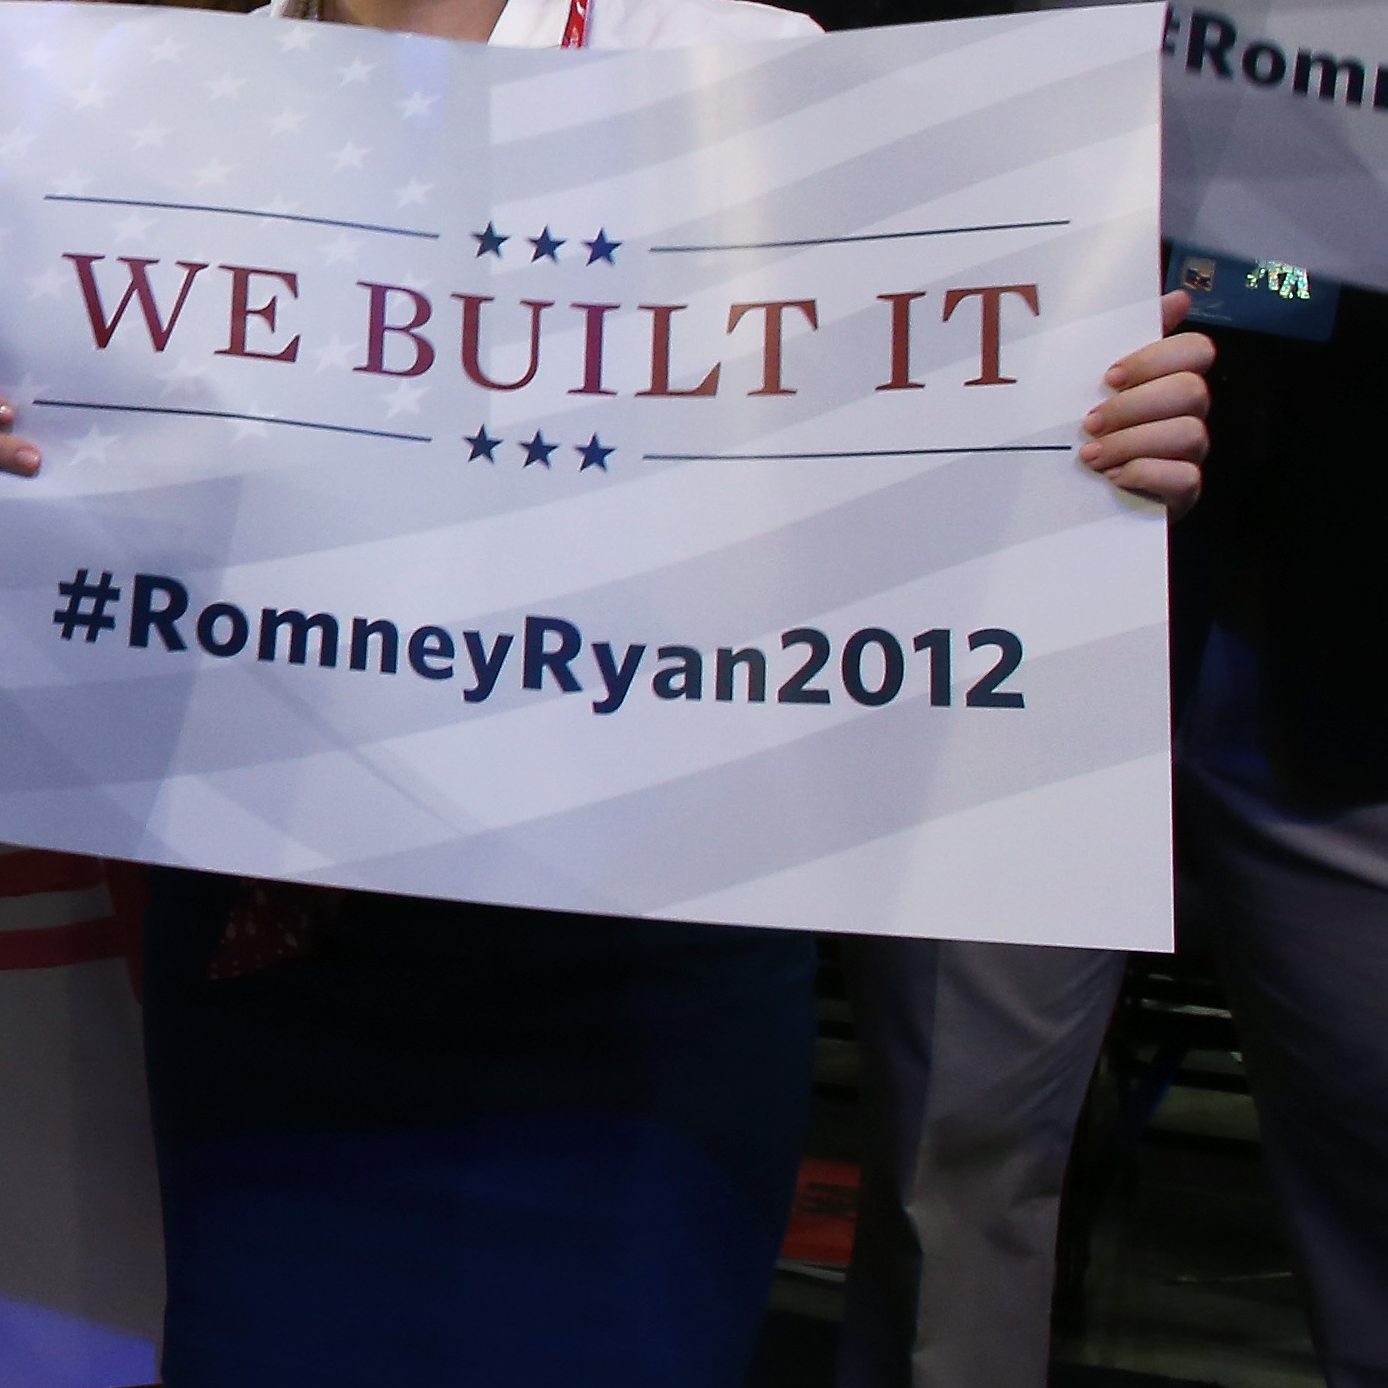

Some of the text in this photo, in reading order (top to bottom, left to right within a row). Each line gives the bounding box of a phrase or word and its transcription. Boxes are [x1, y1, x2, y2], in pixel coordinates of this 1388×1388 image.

[62, 252, 1042, 399] WE BUILT IT
[53, 567, 1027, 716] #RomneyRyan2012
